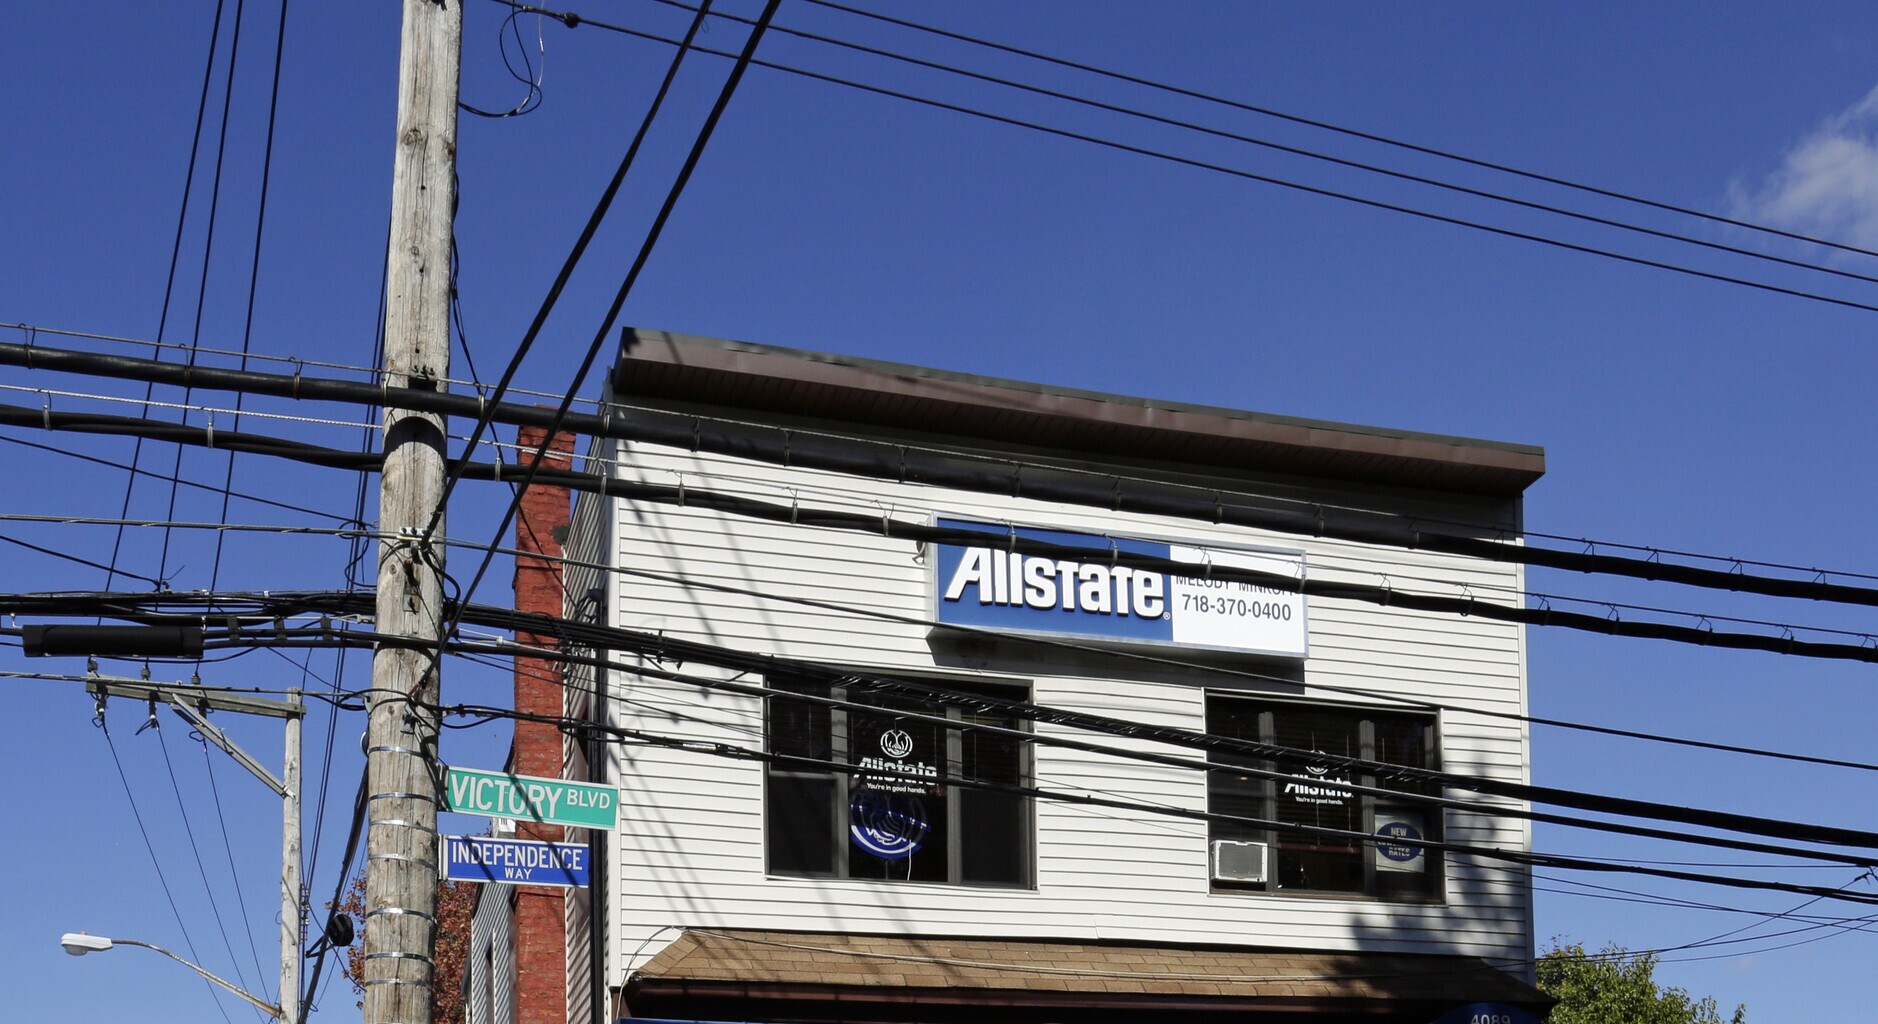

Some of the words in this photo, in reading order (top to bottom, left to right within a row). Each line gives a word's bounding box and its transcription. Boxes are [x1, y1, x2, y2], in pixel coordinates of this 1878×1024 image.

[944, 547, 1165, 619] Allstate
[1182, 594, 1292, 621] 718-370-0400
[451, 773, 564, 819] VICTORY
[567, 789, 611, 809] BLVD
[1390, 827, 1407, 836] NEW
[452, 841, 583, 871] INDEPENDENCE
[504, 868, 533, 880] WAY
